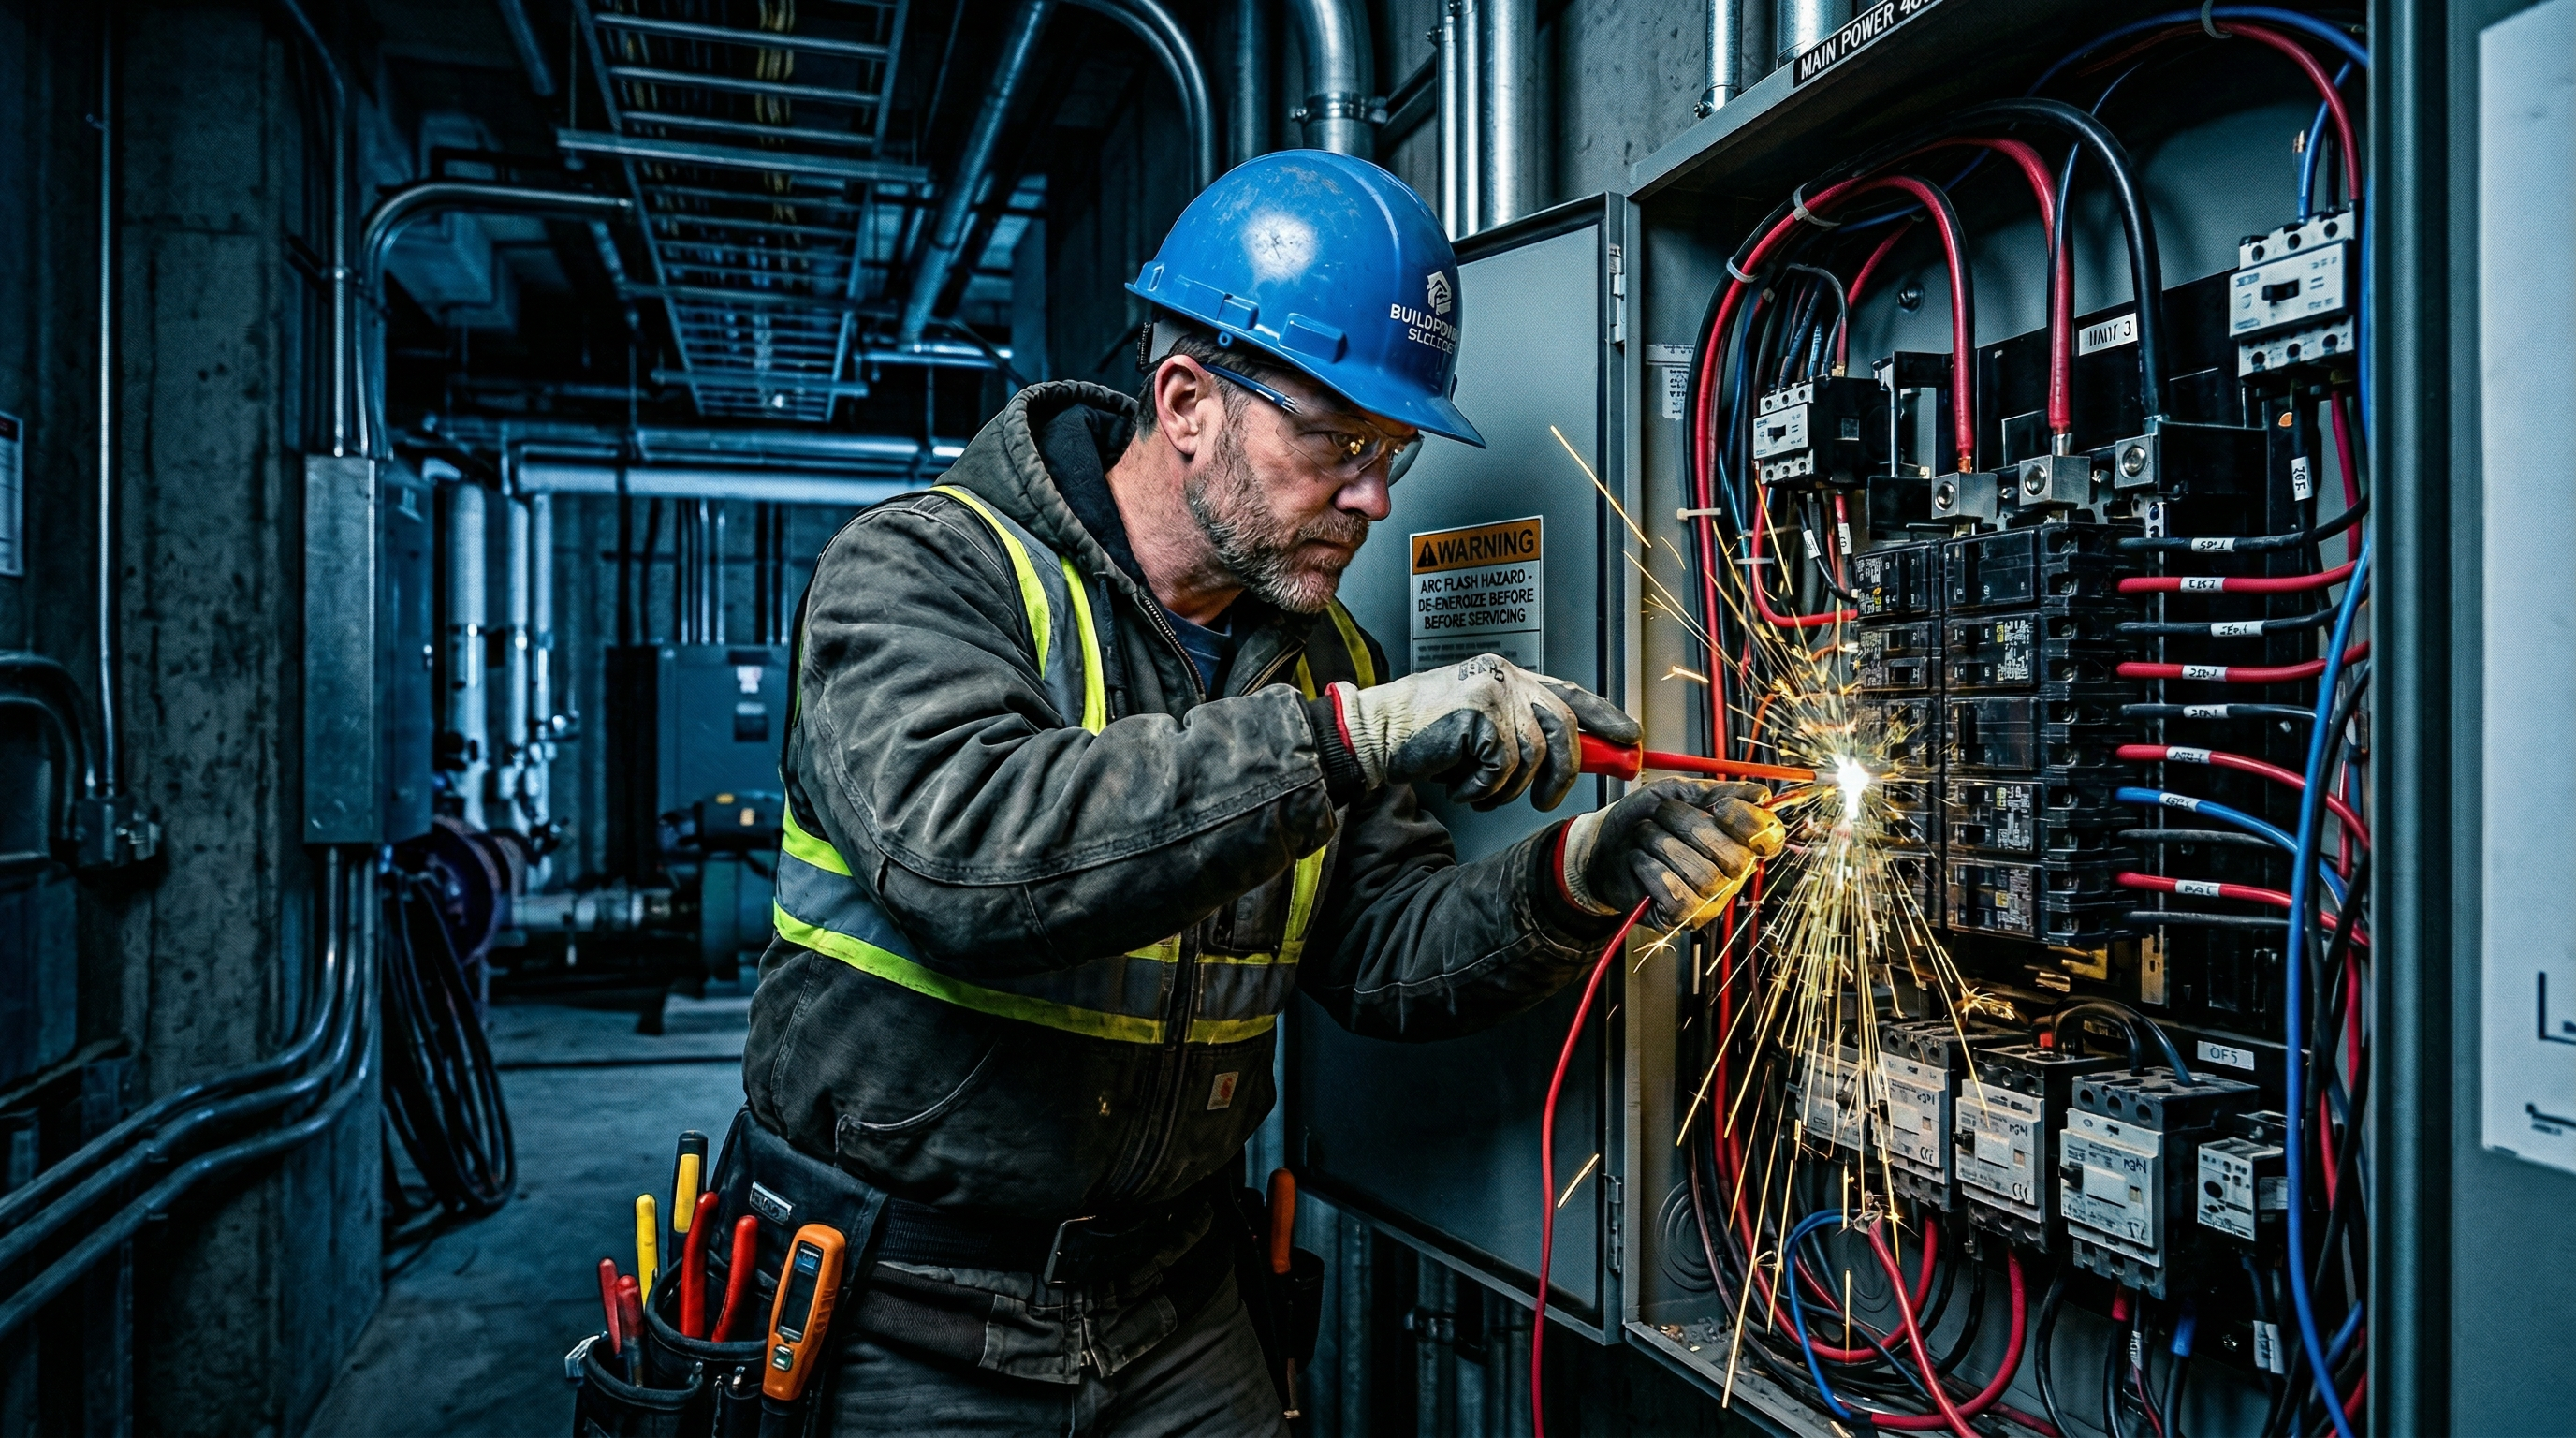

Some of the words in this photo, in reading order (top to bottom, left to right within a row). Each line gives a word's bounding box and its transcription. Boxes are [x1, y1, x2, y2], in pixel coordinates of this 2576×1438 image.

[1801, 38, 1836, 81] MAIN
[1841, 2, 1895, 55] POWER
[1437, 528, 1534, 565] WARNING
[1420, 579, 1442, 594] ARC
[1444, 574, 1478, 592] FLASH
[1482, 568, 1526, 588] HAZARD
[1489, 588, 1534, 607] BEFORE
[1424, 613, 1467, 630] BEFORE
[1468, 608, 1526, 626] SERVICING
